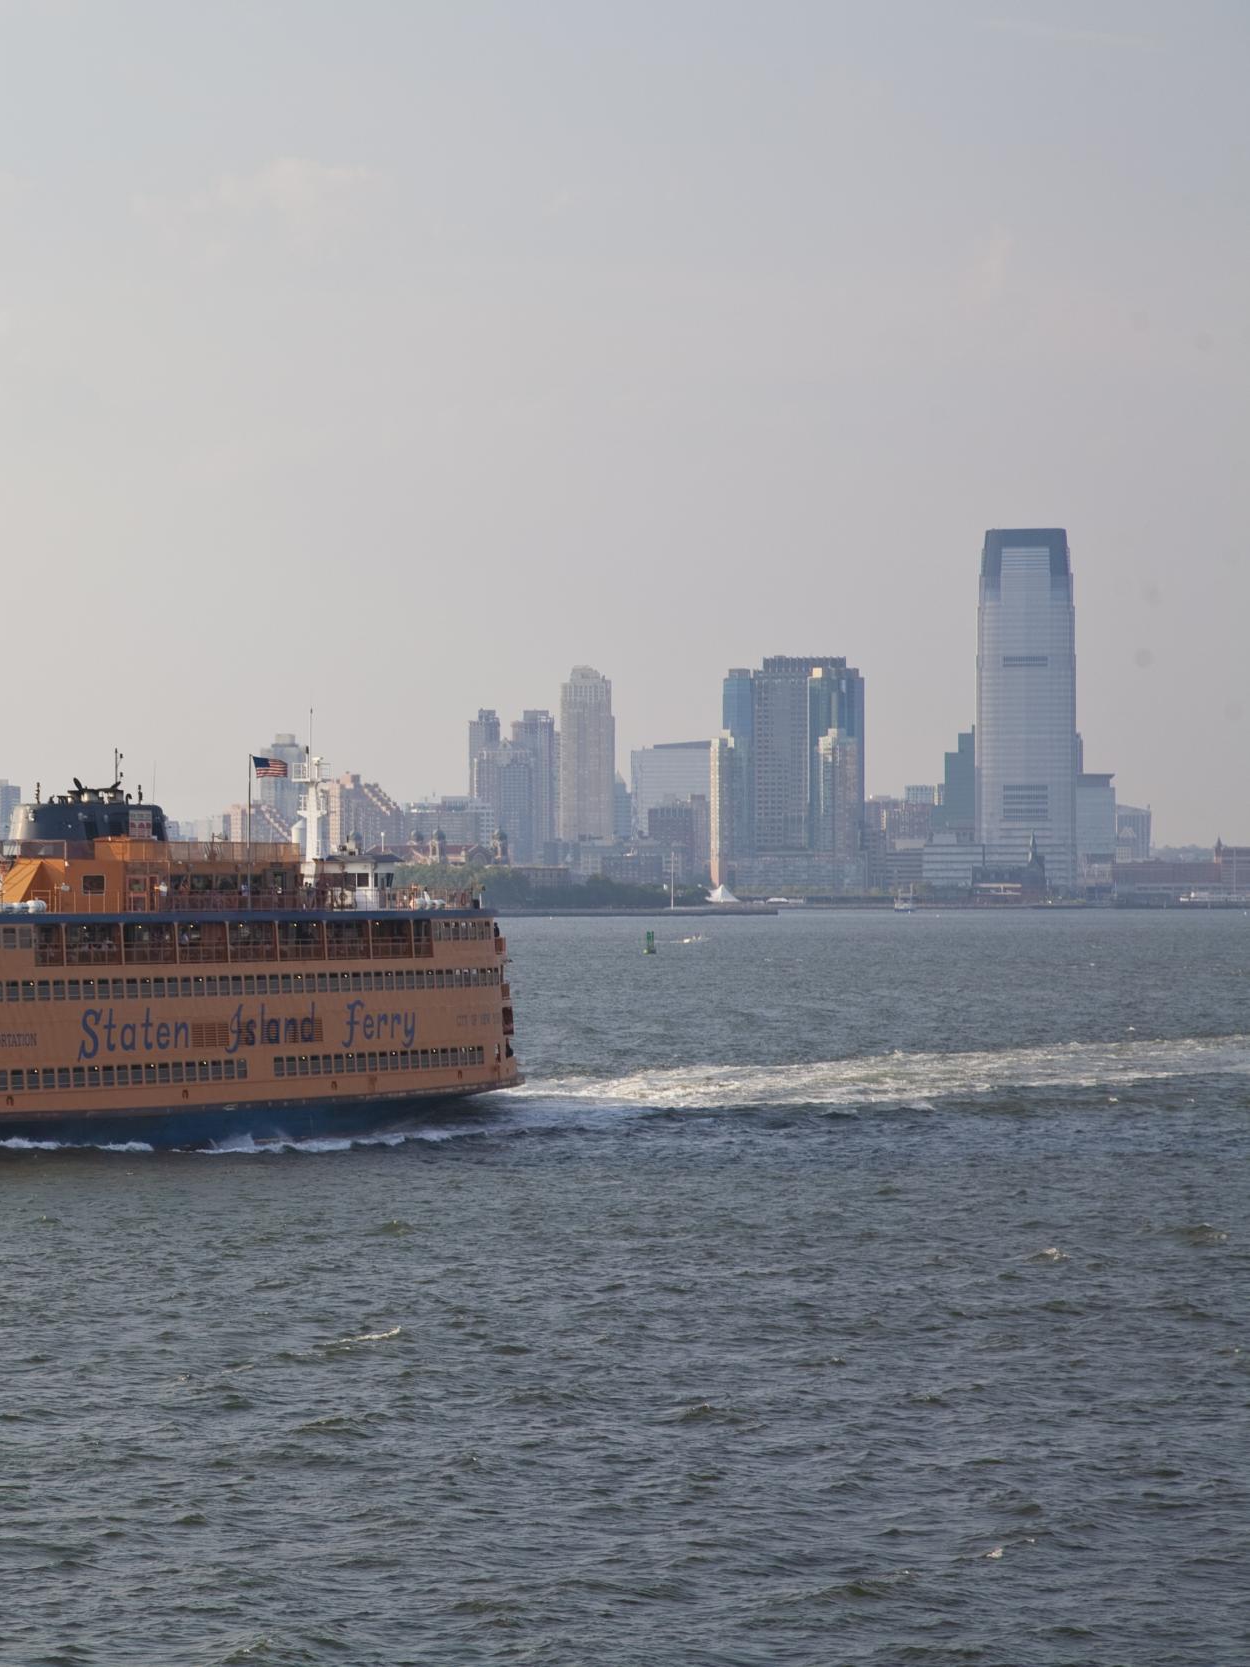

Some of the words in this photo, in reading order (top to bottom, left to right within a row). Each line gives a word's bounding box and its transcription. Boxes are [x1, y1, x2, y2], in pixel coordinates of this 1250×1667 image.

[78, 1008, 189, 1062] Staten
[225, 1002, 315, 1053] Island
[342, 1000, 415, 1048] Ferry
